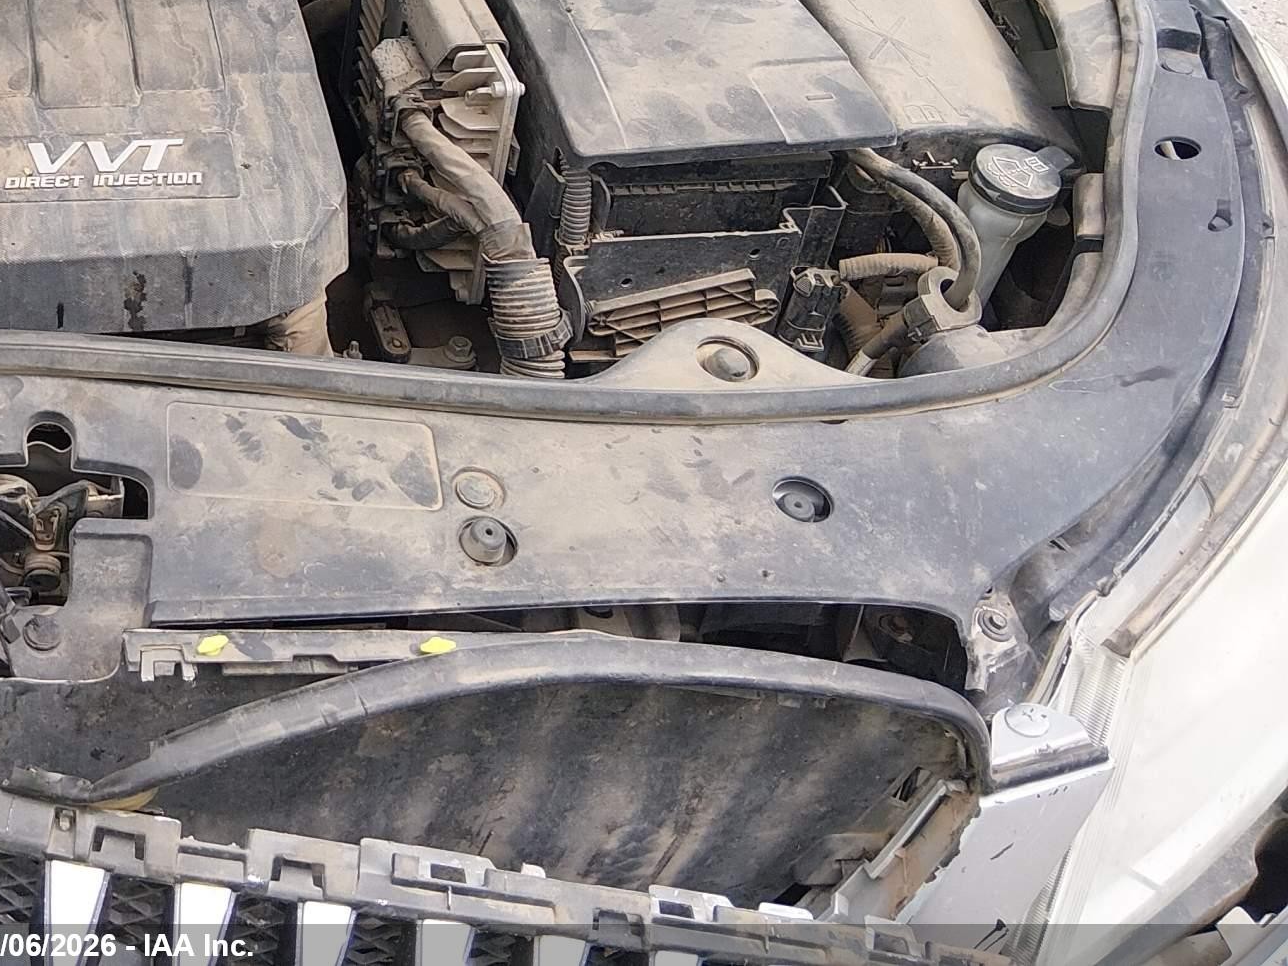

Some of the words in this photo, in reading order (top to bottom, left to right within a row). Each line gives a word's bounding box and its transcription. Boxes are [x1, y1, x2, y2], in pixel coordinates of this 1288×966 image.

[27, 138, 184, 174] VVT
[4, 174, 84, 189] DIRECT
[93, 172, 203, 187] INJECTION
